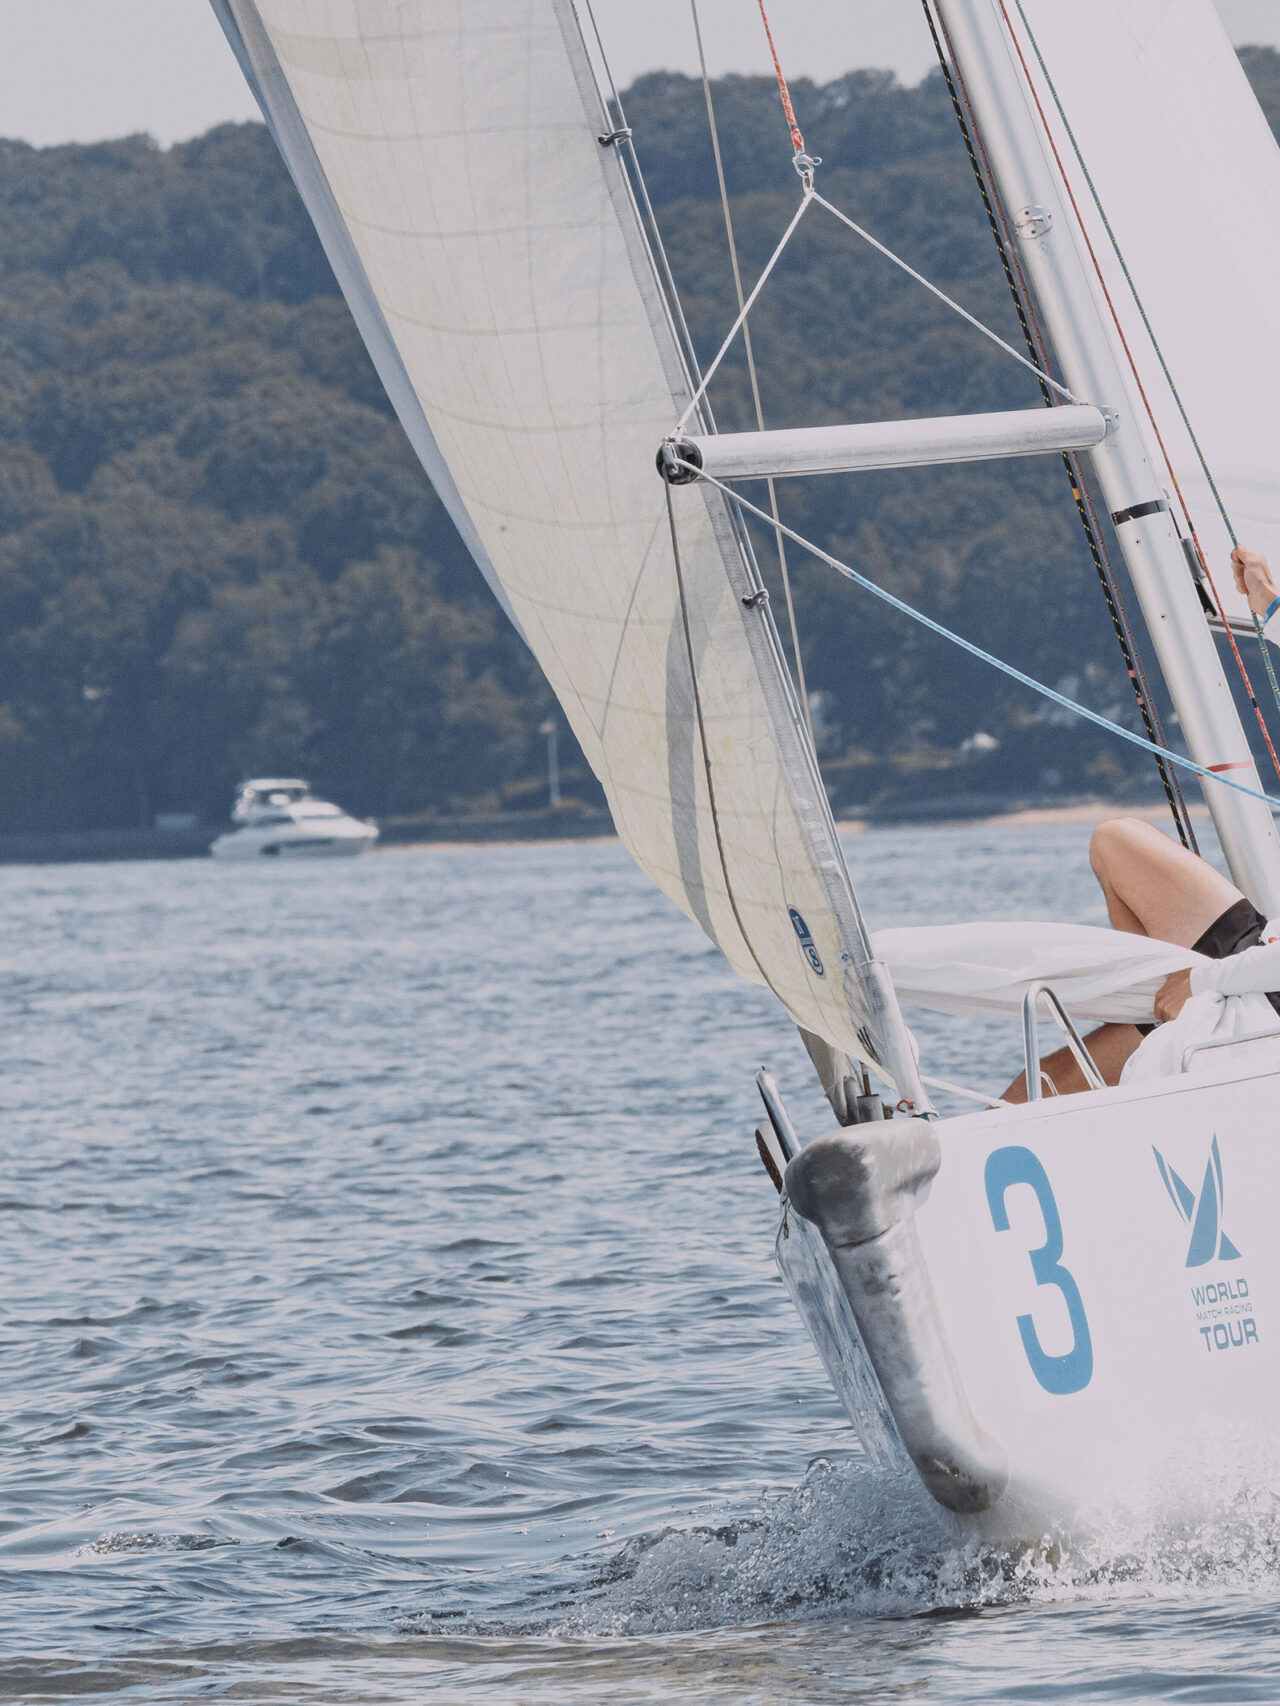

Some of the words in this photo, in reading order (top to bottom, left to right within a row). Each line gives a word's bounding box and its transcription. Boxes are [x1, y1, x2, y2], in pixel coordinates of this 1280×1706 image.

[983, 1145, 1094, 1396] 3
[1190, 1278, 1249, 1307] WORLD
[1196, 1309, 1223, 1321] MATCH
[1224, 1302, 1253, 1316] RACING
[1199, 1318, 1259, 1352] TOUR
